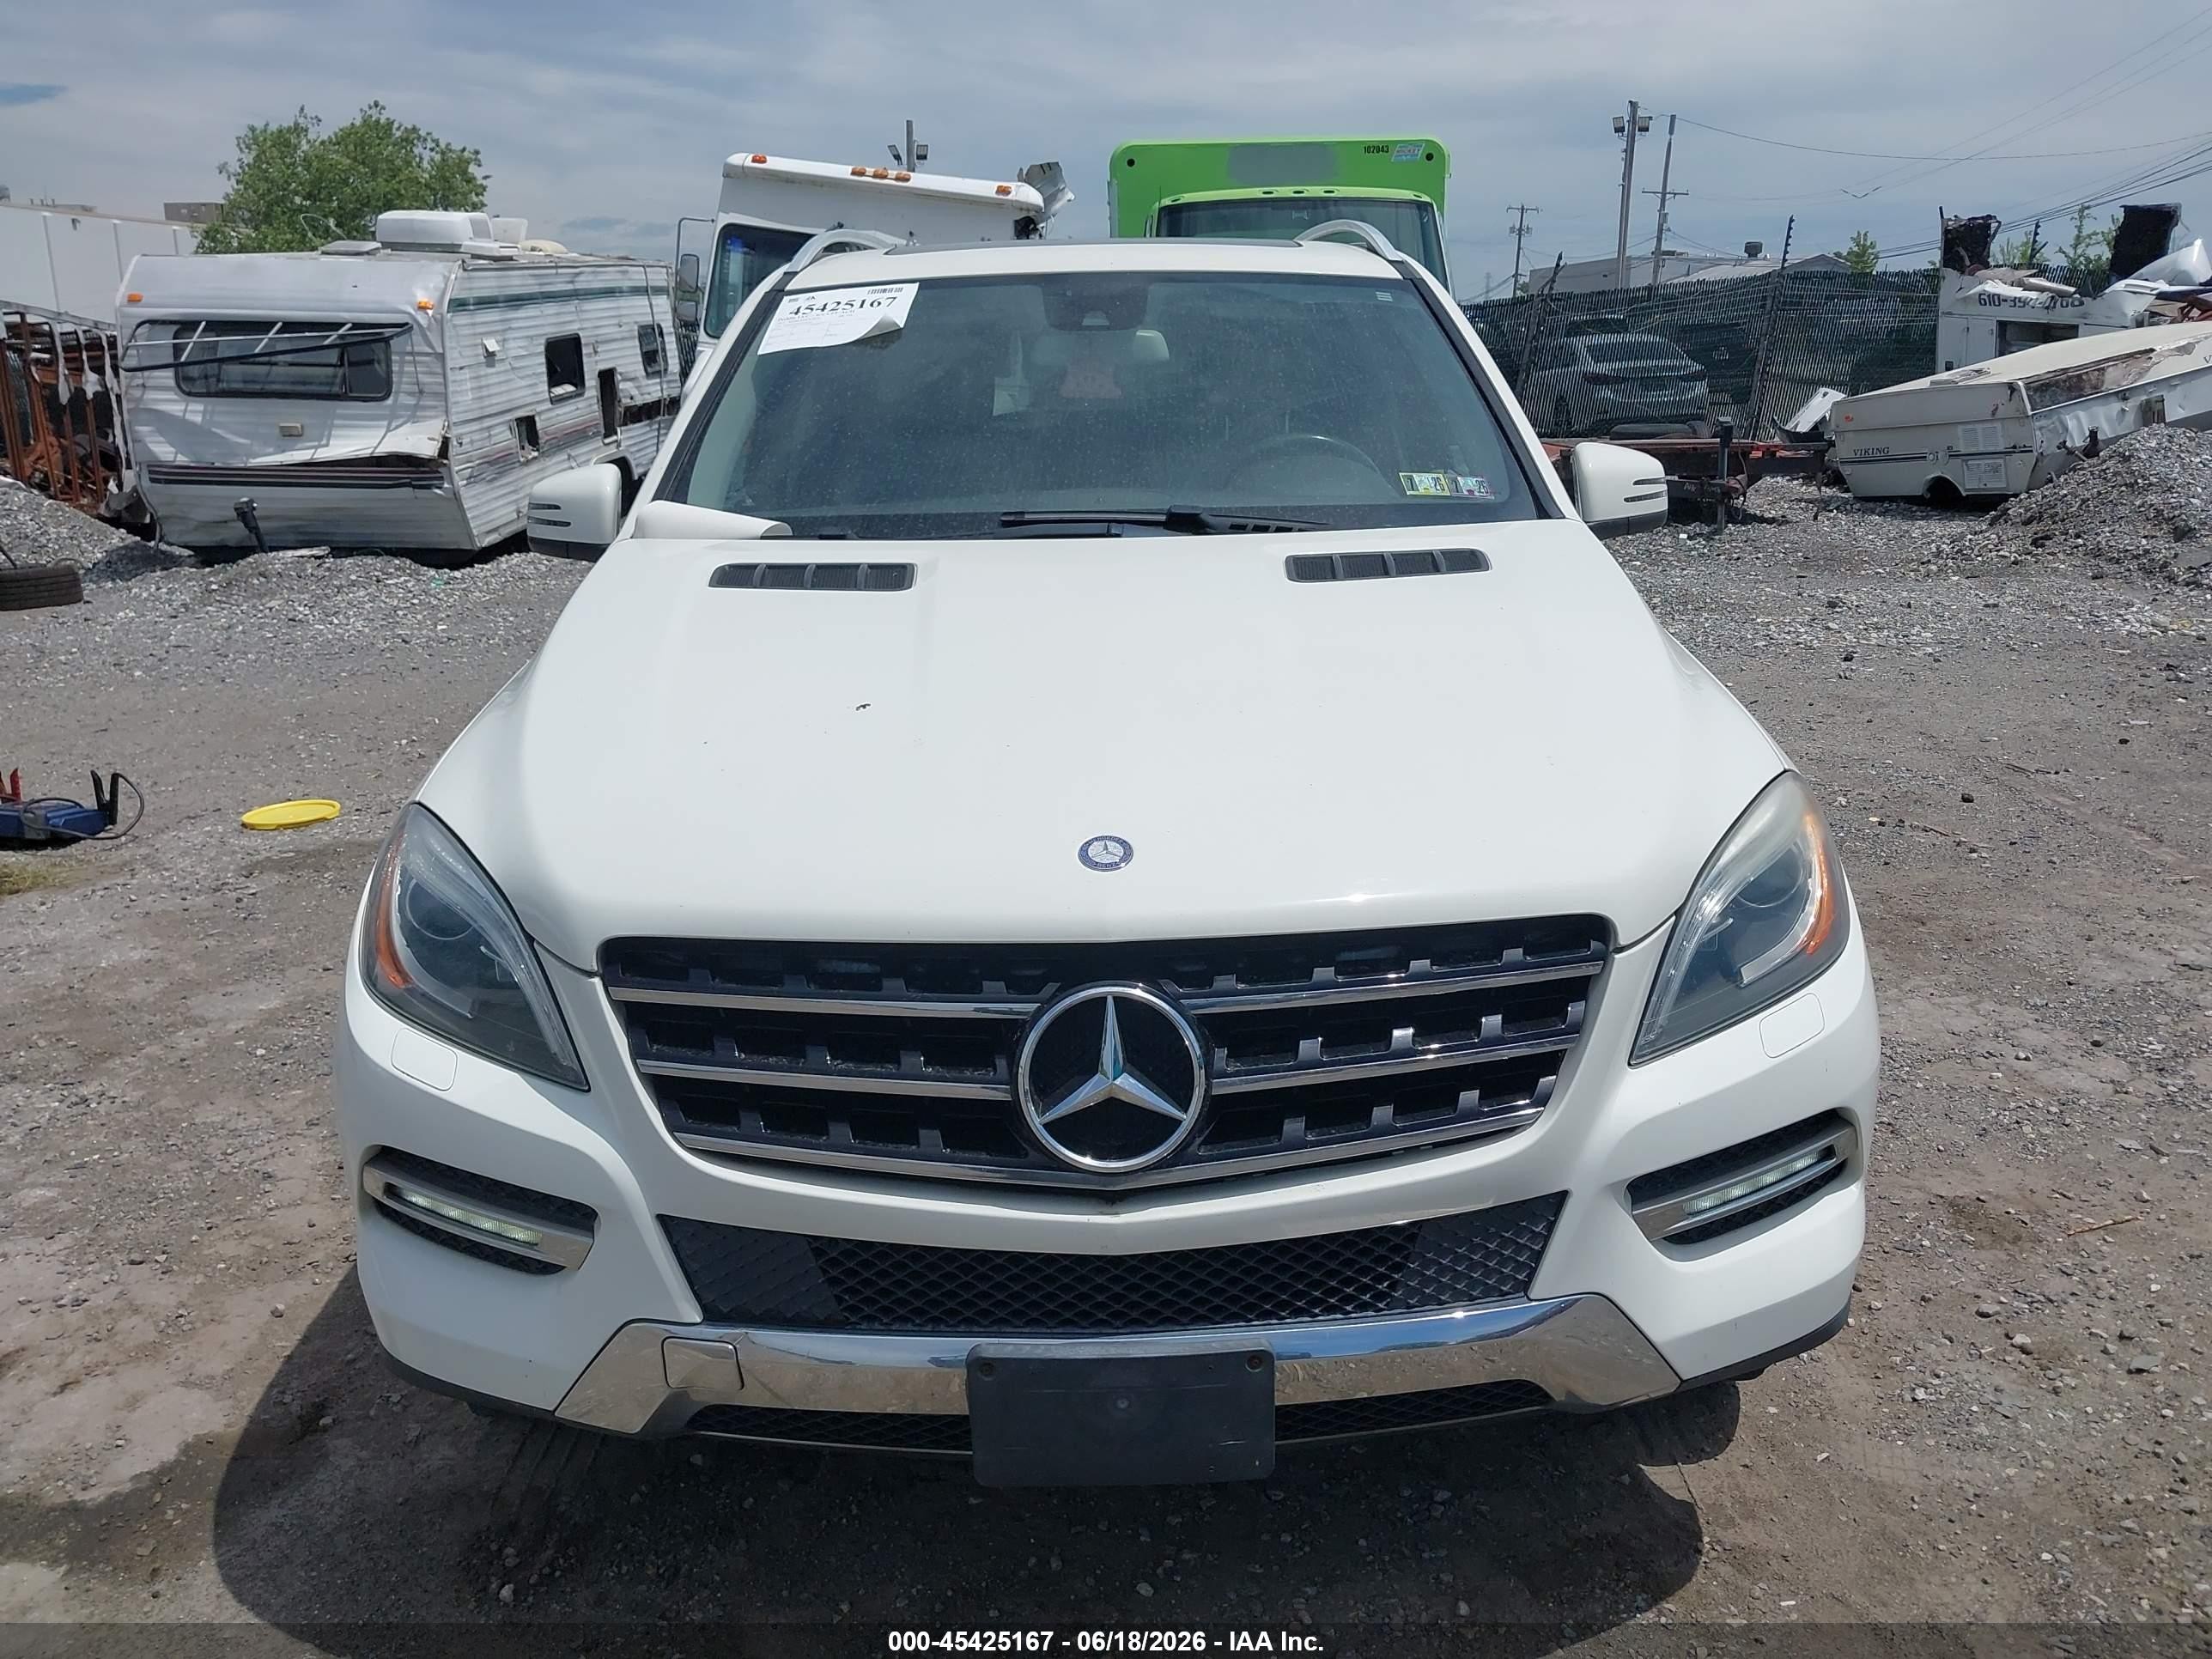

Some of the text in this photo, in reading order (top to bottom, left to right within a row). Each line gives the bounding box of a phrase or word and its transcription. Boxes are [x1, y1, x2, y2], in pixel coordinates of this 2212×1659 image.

[1364, 145, 1389, 155] 102043
[788, 296, 898, 316] 45425167
[1852, 447, 1890, 457] VIKING
[1407, 477, 1415, 492] 7
